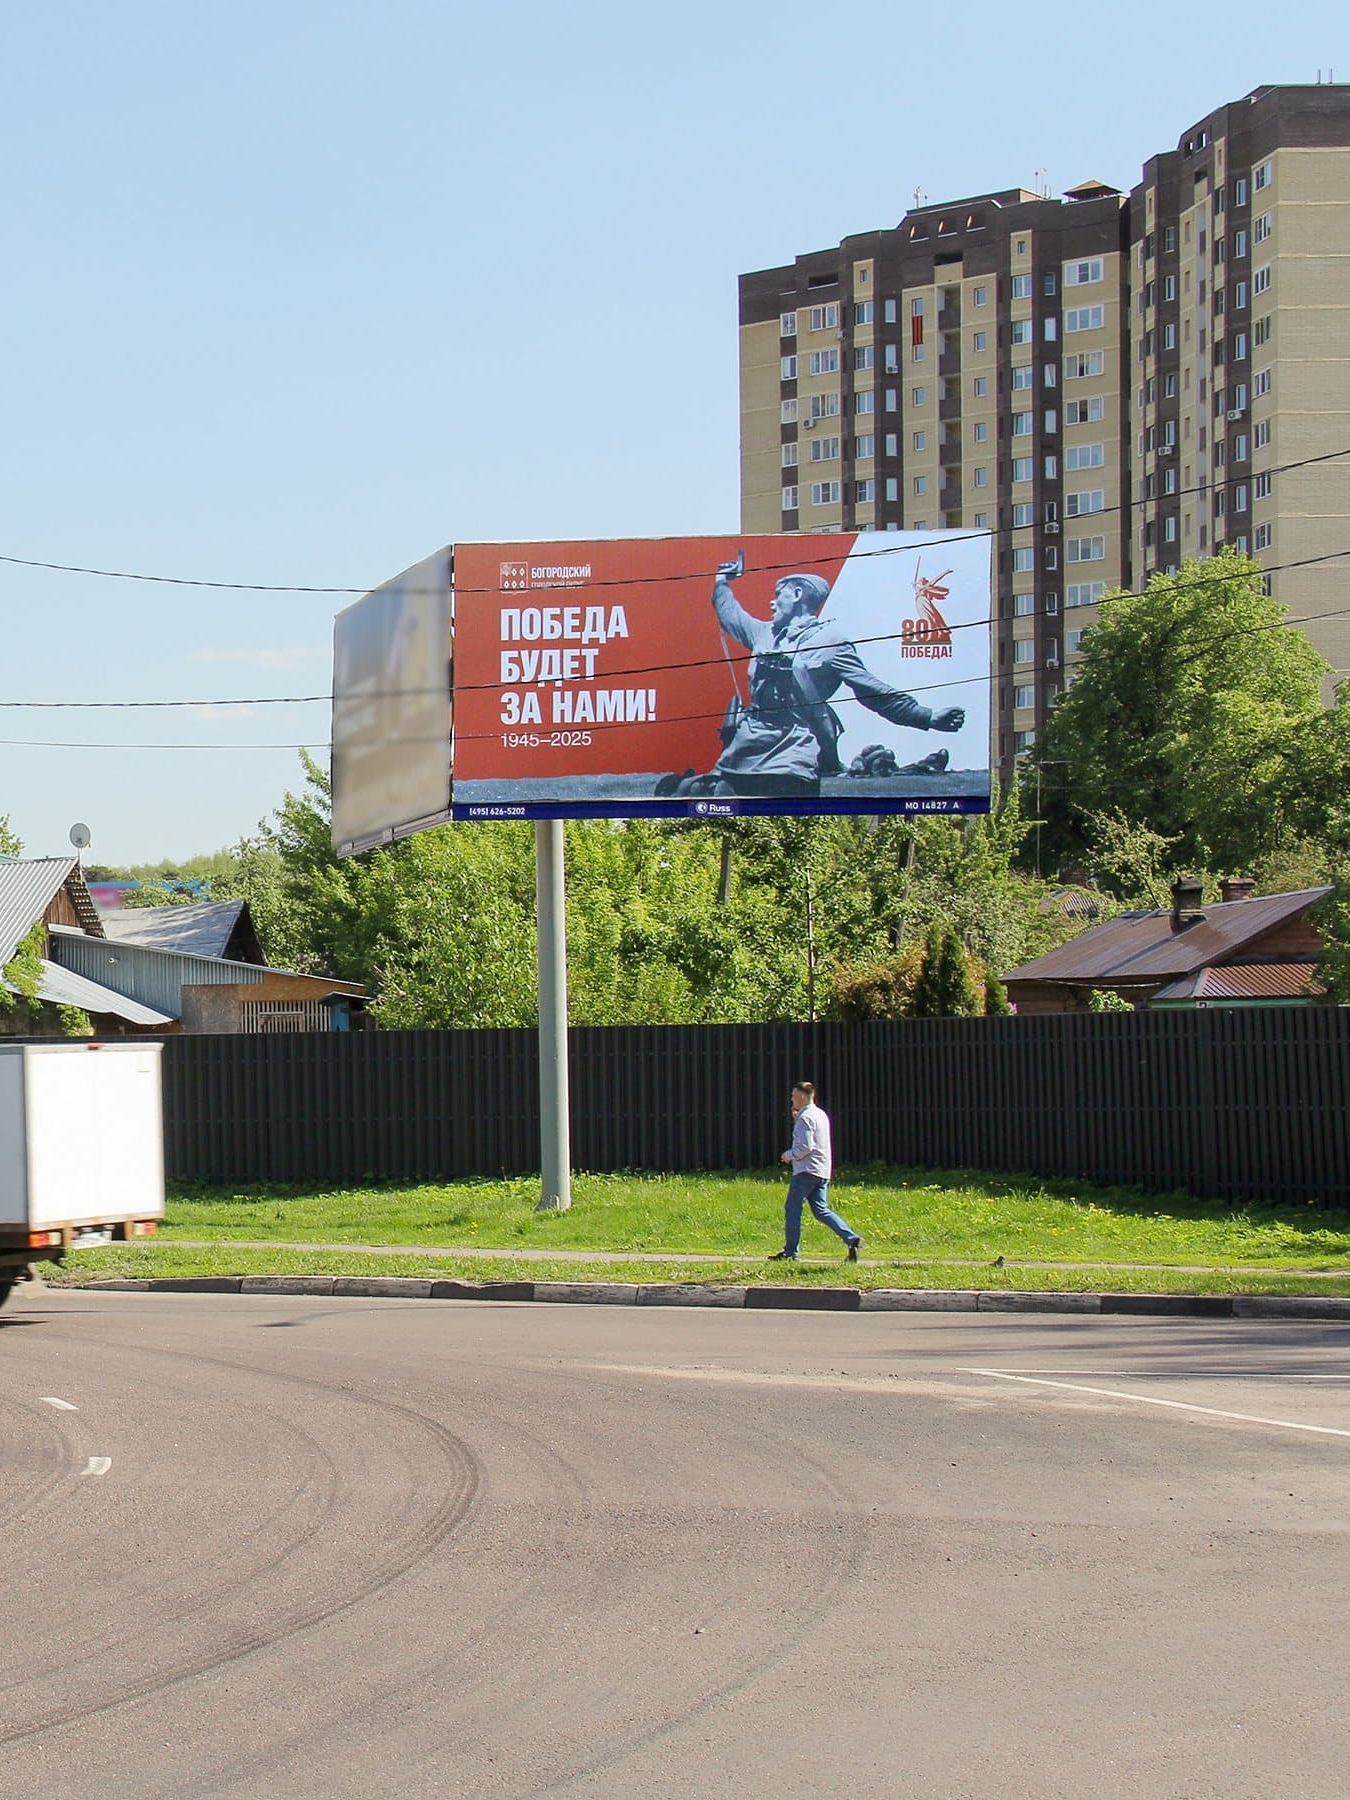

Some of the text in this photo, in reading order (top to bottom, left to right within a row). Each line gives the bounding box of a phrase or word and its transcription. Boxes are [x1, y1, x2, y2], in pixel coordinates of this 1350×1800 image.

[531, 564, 591, 579] БОГОРОДСКИЙ
[500, 605, 629, 644] ПОБЕДА
[901, 618, 929, 642] 80
[901, 646, 952, 660] ПОБЕДА!
[500, 648, 599, 687] БУДЕТ
[500, 688, 657, 725] ЗА НАМИ!
[490, 807, 526, 816] 626-5202
[709, 804, 731, 812] Russ
